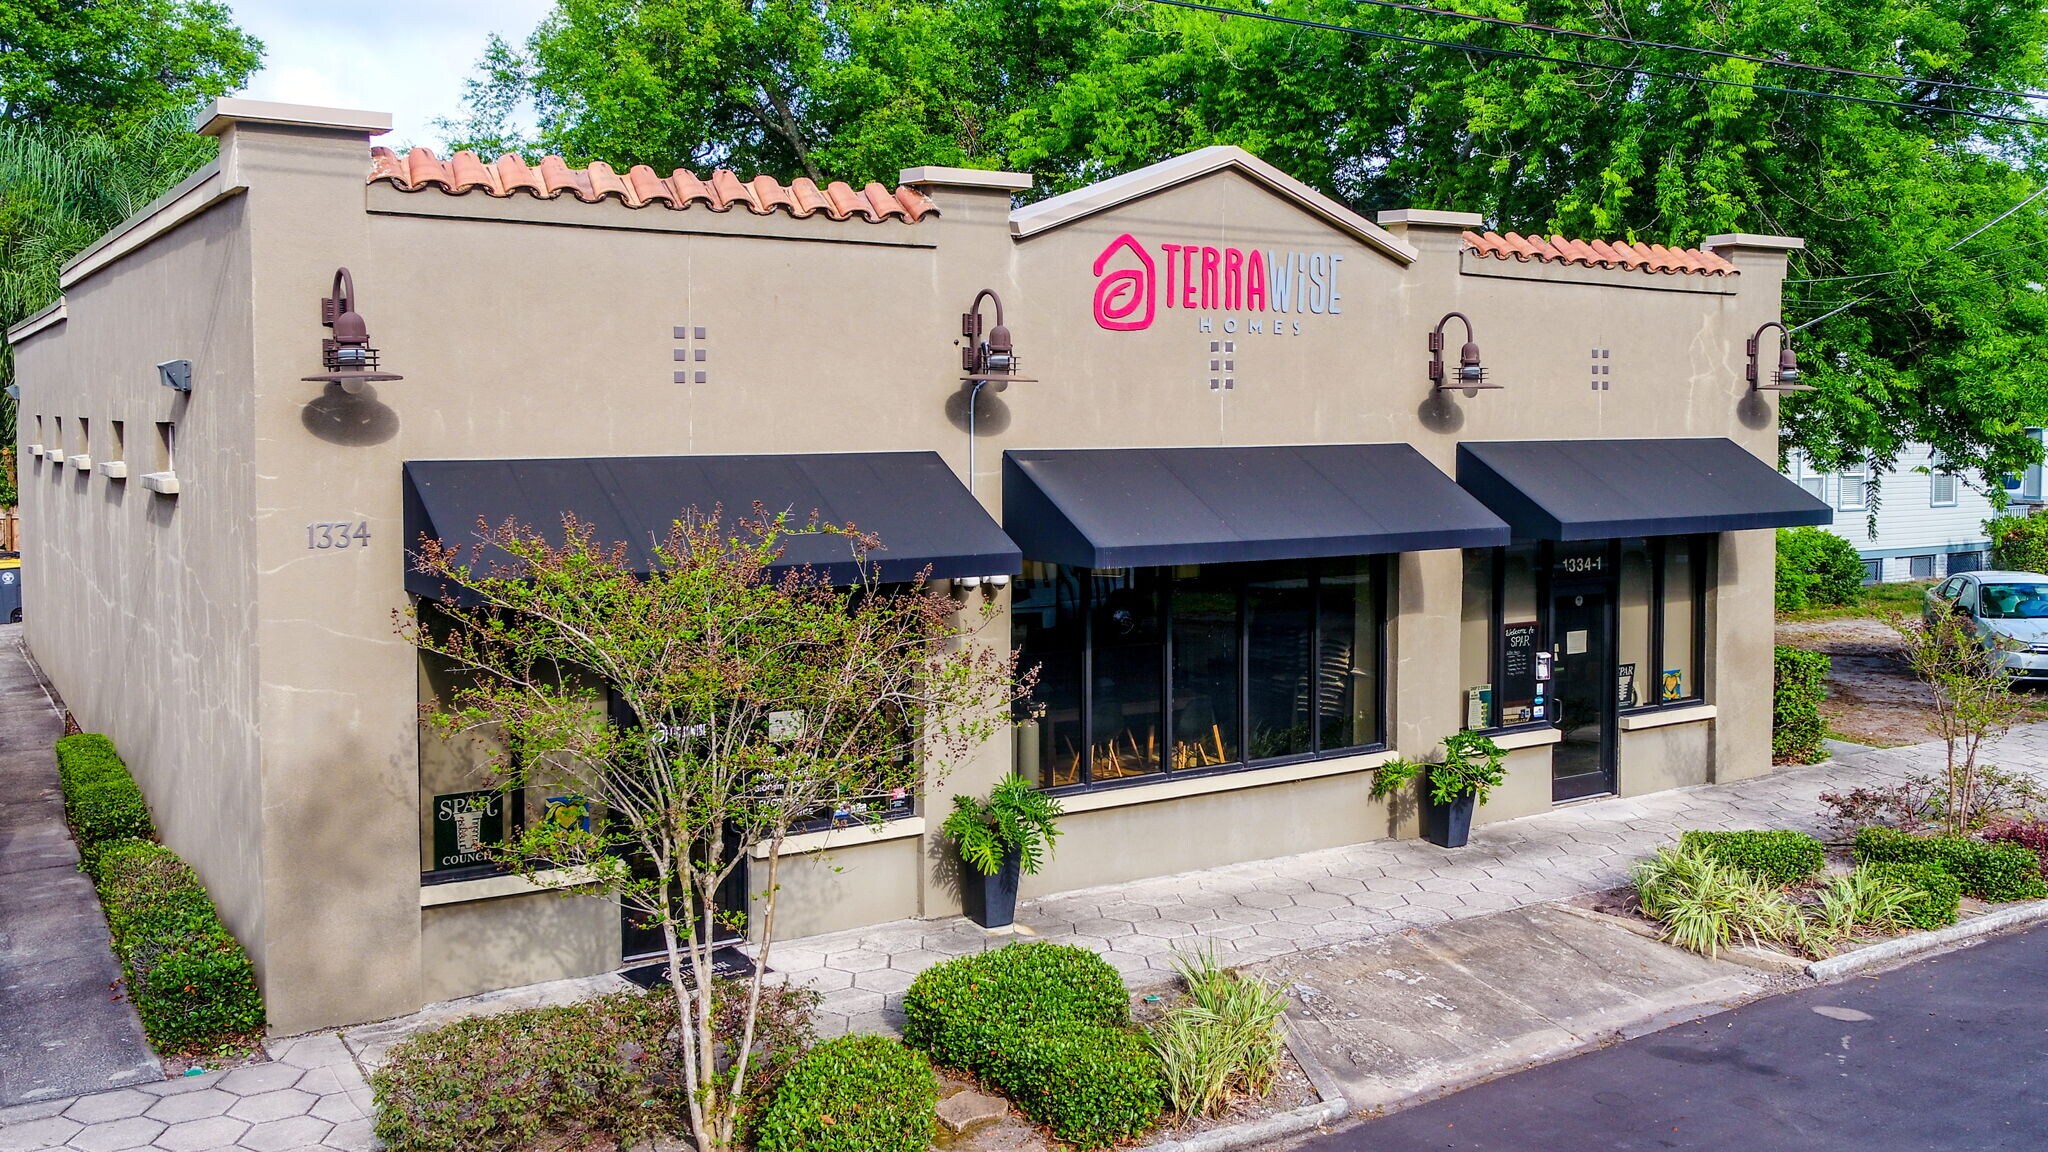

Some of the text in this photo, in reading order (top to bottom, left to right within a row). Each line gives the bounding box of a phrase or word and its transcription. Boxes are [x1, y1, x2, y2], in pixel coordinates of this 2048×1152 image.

[1199, 316, 1301, 336] HOMES
[306, 520, 371, 549] 1334
[1562, 556, 1601, 572] 1334-1
[1510, 635, 1530, 648] SPAR
[1619, 665, 1634, 677] PAR
[438, 794, 498, 821] SPAR
